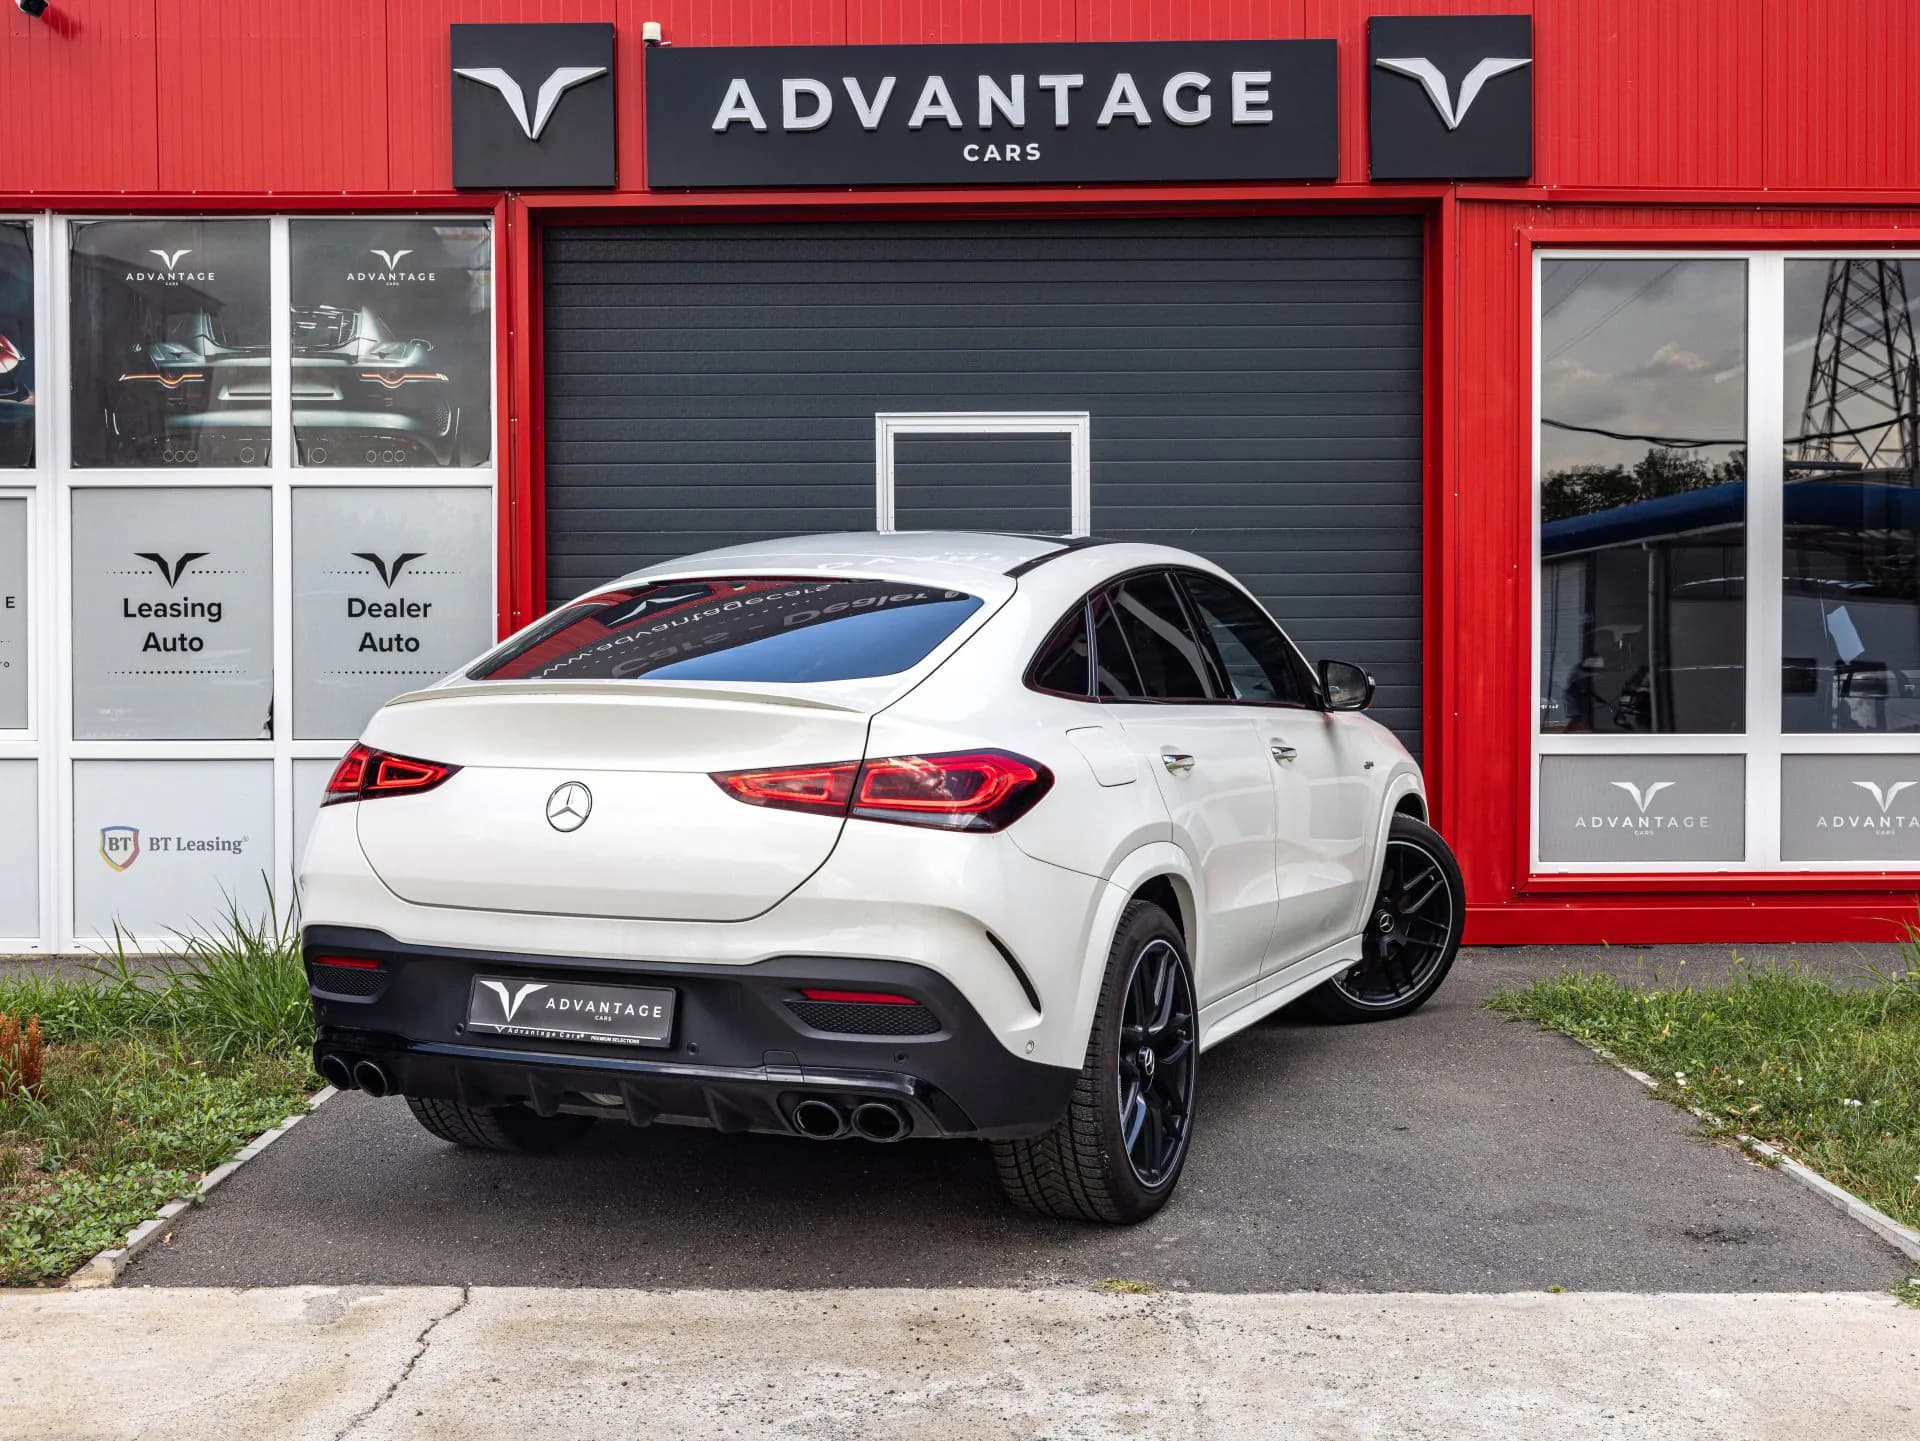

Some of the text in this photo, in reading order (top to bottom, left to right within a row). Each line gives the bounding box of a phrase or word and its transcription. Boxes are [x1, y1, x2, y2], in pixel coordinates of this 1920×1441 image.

[711, 70, 1274, 132] ADVANTAGE
[963, 143, 1042, 162] CARS
[126, 272, 216, 281] ADVANTAGE
[346, 272, 436, 281] ADVANTAGE
[123, 597, 223, 622] Leasing
[347, 597, 432, 618] Dealer
[142, 632, 204, 653] Auto
[358, 632, 420, 653] Auto
[1575, 816, 1710, 828] ADVANTAGE
[1816, 816, 1920, 828] ADVANTA
[108, 837, 132, 851] BT
[149, 837, 172, 851] BT
[546, 998, 662, 1018] ADVANTAGE
[594, 1014, 613, 1022] CARS
[507, 1026, 556, 1038] Advantage
